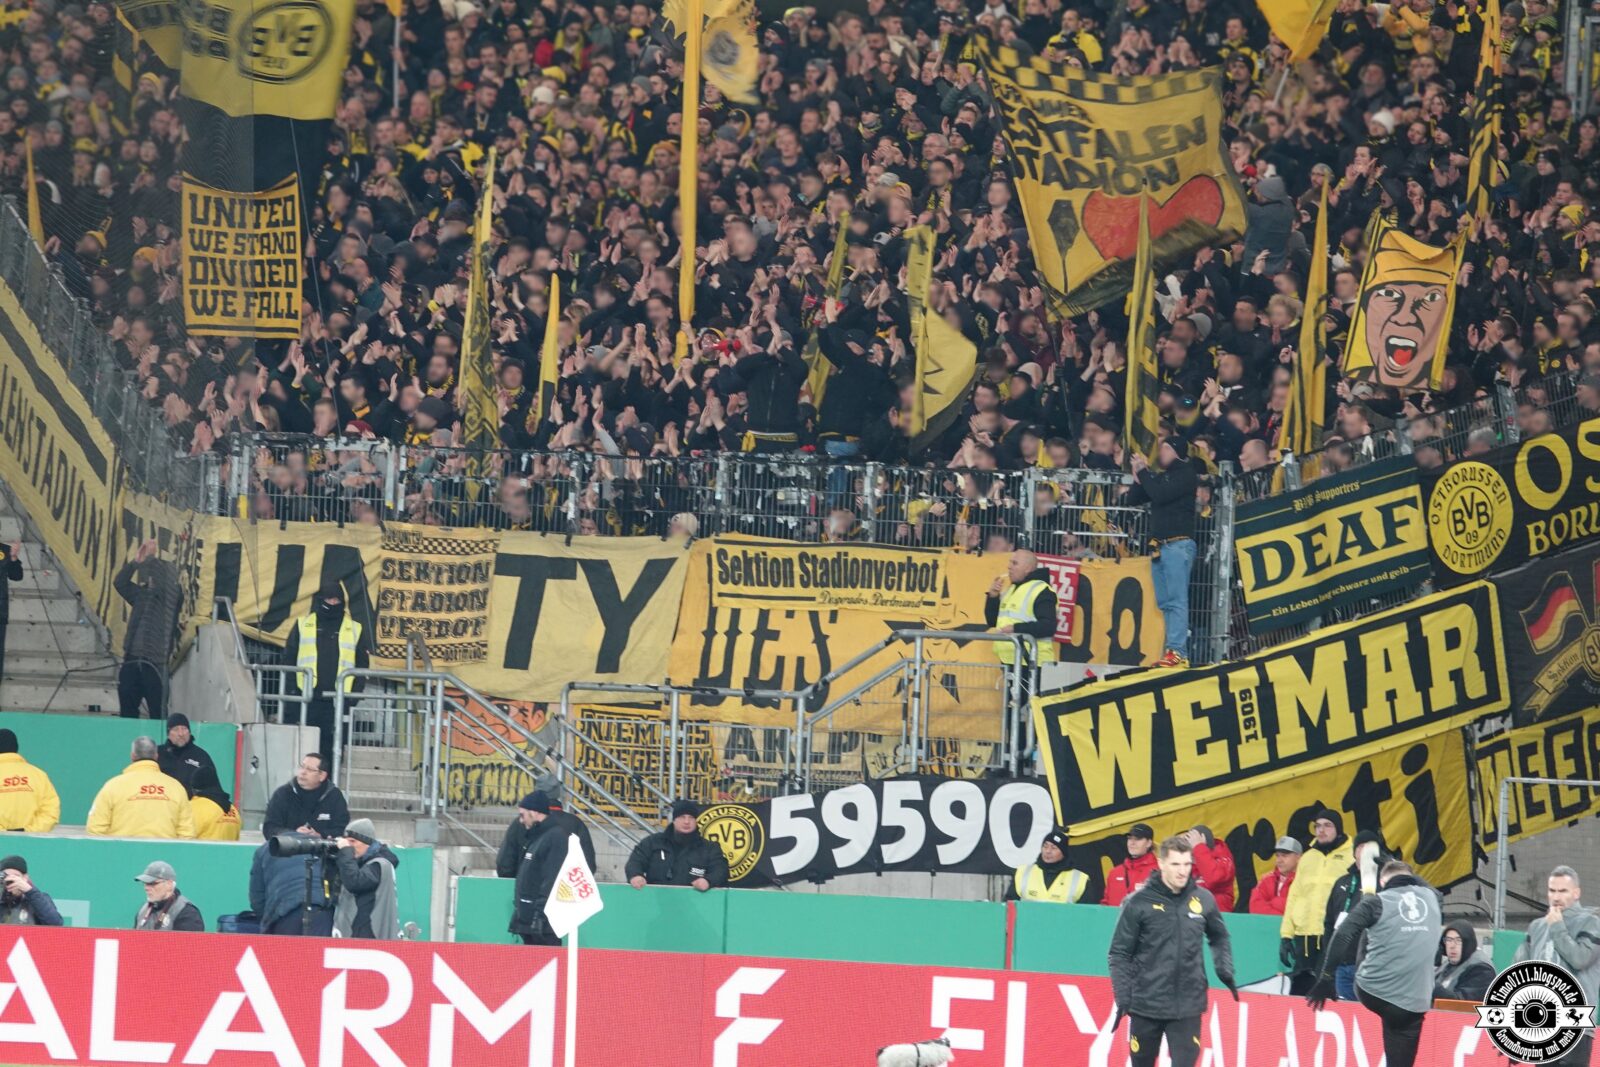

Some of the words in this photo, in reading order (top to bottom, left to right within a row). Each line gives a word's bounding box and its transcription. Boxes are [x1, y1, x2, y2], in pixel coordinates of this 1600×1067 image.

[188, 193, 296, 229] UNITED
[188, 228, 229, 253] WE
[233, 231, 297, 256] STAND
[188, 256, 298, 288] DIVIDED
[189, 288, 237, 317] WE
[243, 291, 299, 320] FALL
[1451, 492, 1490, 536] BVB
[1242, 495, 1419, 592] DEAF
[1465, 530, 1479, 545] 09
[381, 557, 492, 585] SEKTION
[716, 548, 795, 588] Sektion
[798, 551, 938, 593] Stadionverbot
[379, 587, 490, 614] STADION
[1271, 606, 1288, 617] Ein
[1290, 598, 1319, 612] Leben
[1370, 571, 1388, 584] und
[1388, 565, 1409, 580] gelb
[378, 615, 487, 640] VERBOT
[1058, 603, 1488, 809] WEIMAR
[1238, 687, 1259, 743] 1909
[4, 776, 28, 787] SDS
[140, 784, 165, 795] SDS
[770, 780, 1054, 875] 59590
